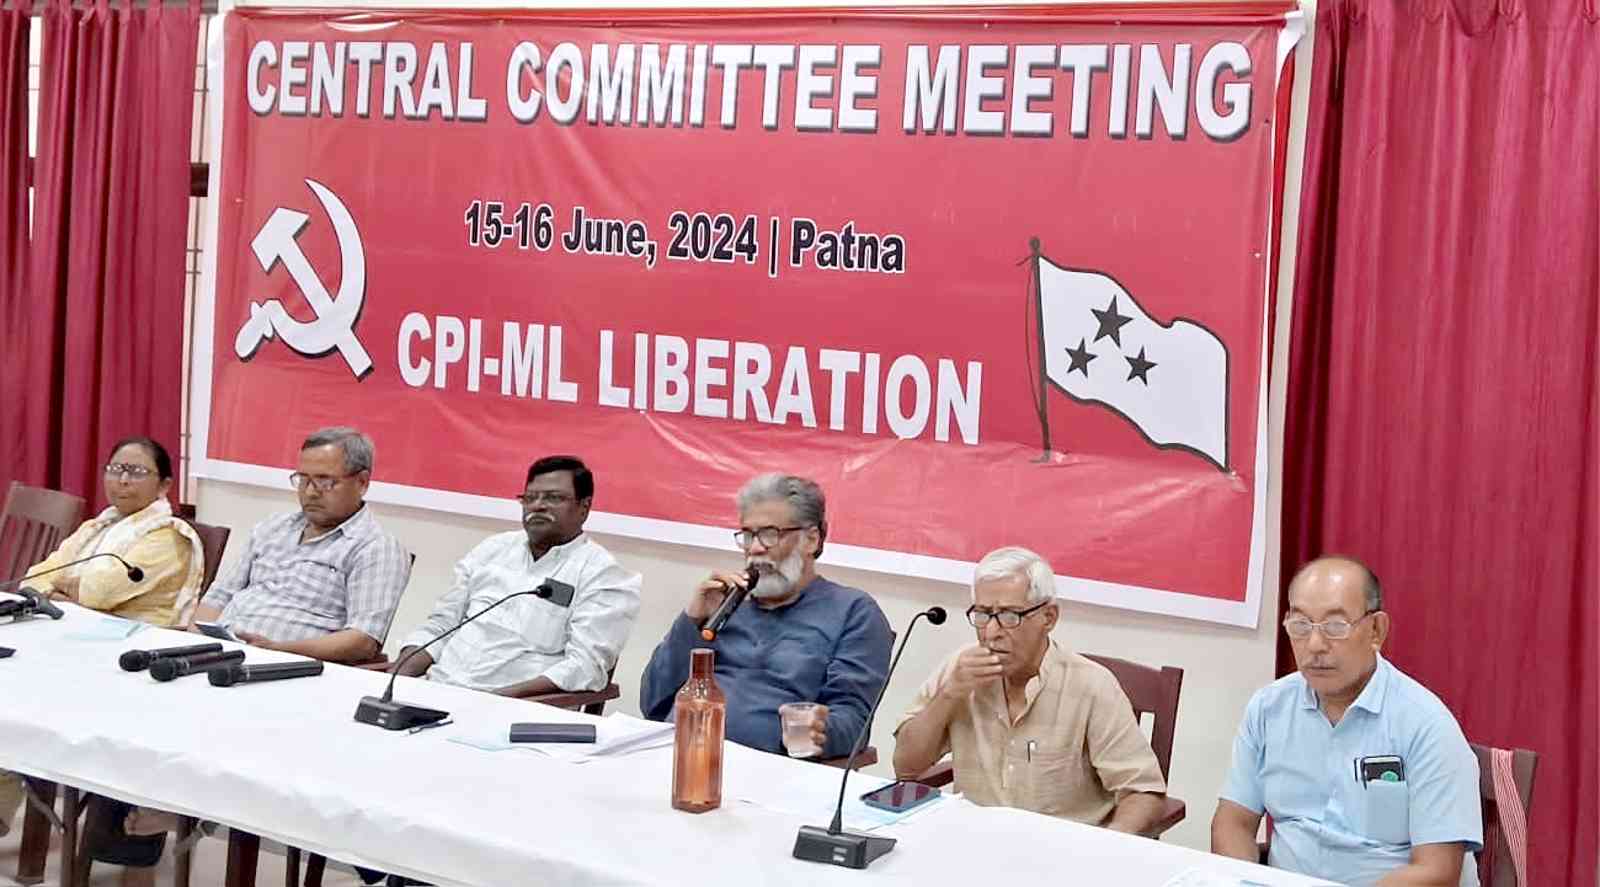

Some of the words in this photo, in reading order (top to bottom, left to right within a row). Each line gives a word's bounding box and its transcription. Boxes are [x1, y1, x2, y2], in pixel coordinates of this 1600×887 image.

[246, 40, 487, 121] CENTRAL
[505, 41, 881, 132] COMMITTEE
[902, 41, 1253, 142] MEETING
[465, 201, 553, 250] 15-16
[563, 206, 657, 267] June,
[667, 211, 758, 263] 2024
[790, 218, 905, 274] Patna
[398, 312, 578, 403] CPI-ML
[598, 329, 982, 445] LIBERATION
